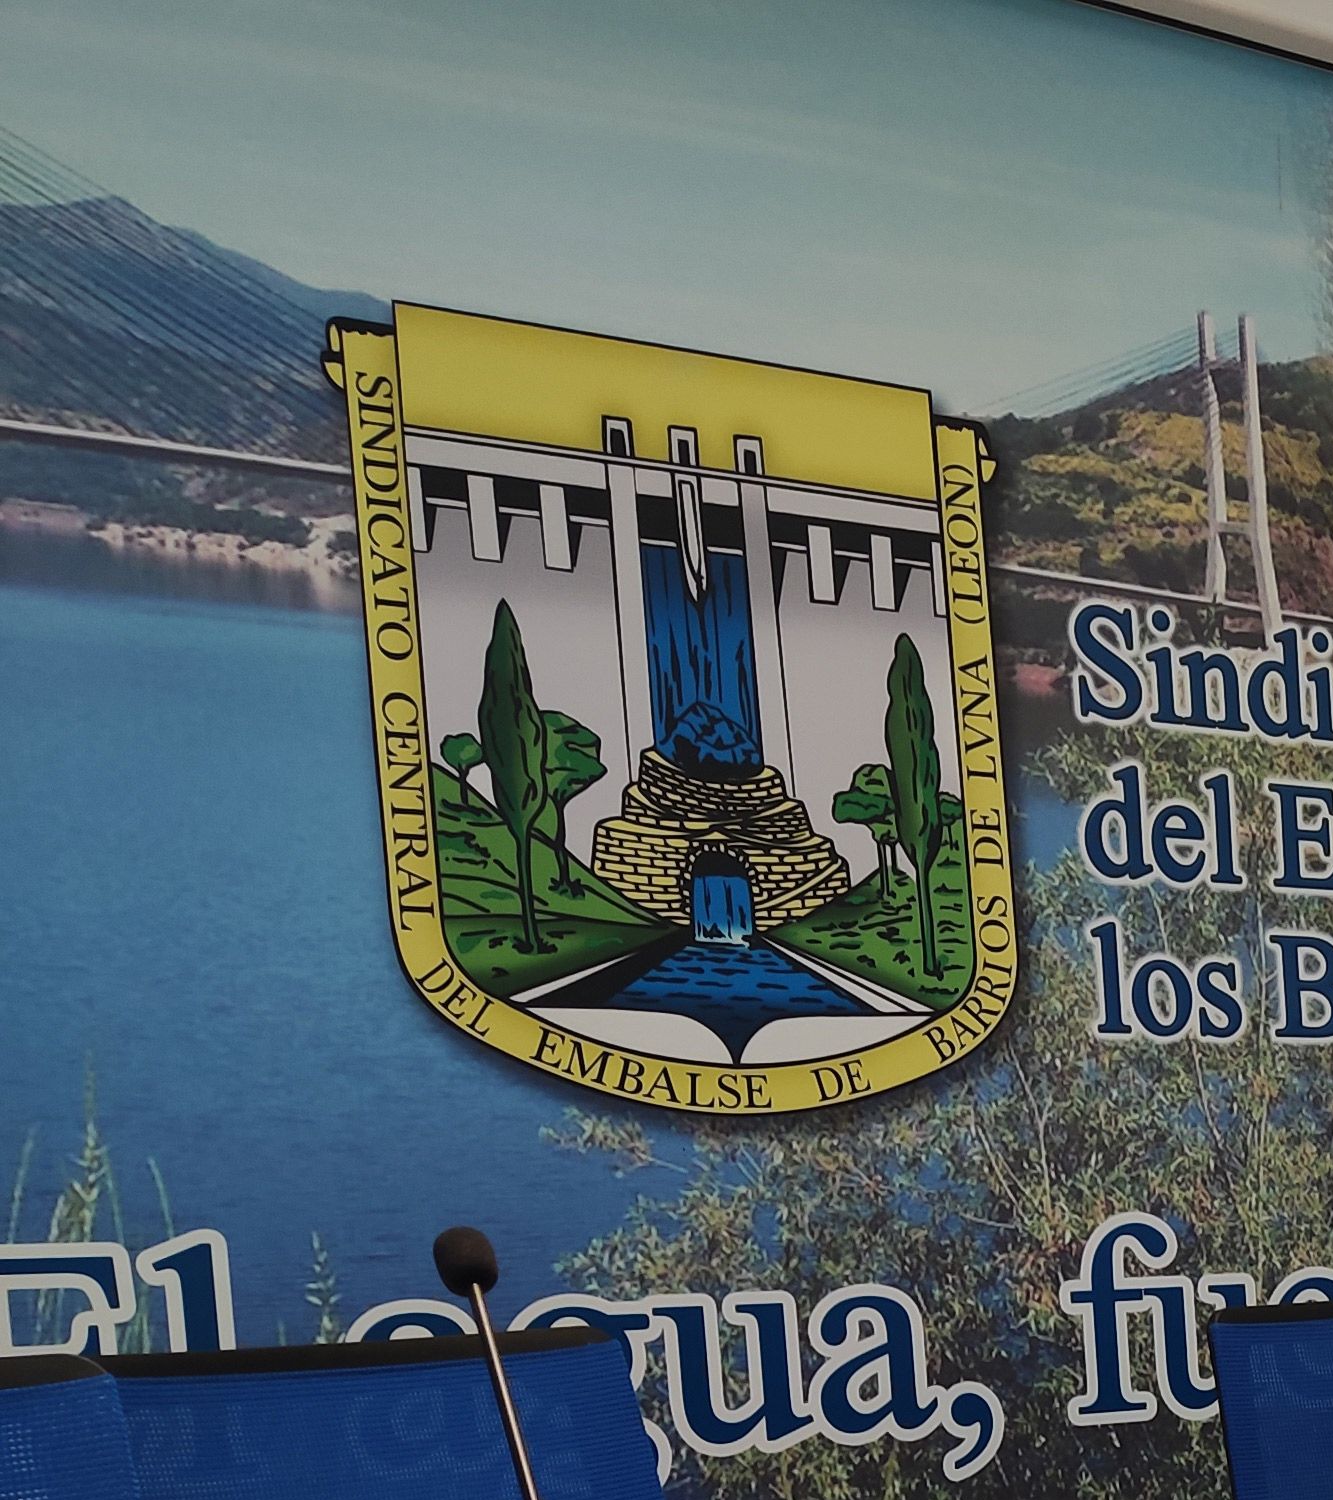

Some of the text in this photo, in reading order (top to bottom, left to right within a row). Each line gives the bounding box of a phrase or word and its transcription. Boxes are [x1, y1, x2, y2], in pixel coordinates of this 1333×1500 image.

[354, 371, 1013, 1110] SINDICATO CENTRAL DEL EMBALSE DE BARRIOS DE LVNA (LEON)
[1082, 766, 1242, 886] del
[1090, 921, 1243, 1038] los
